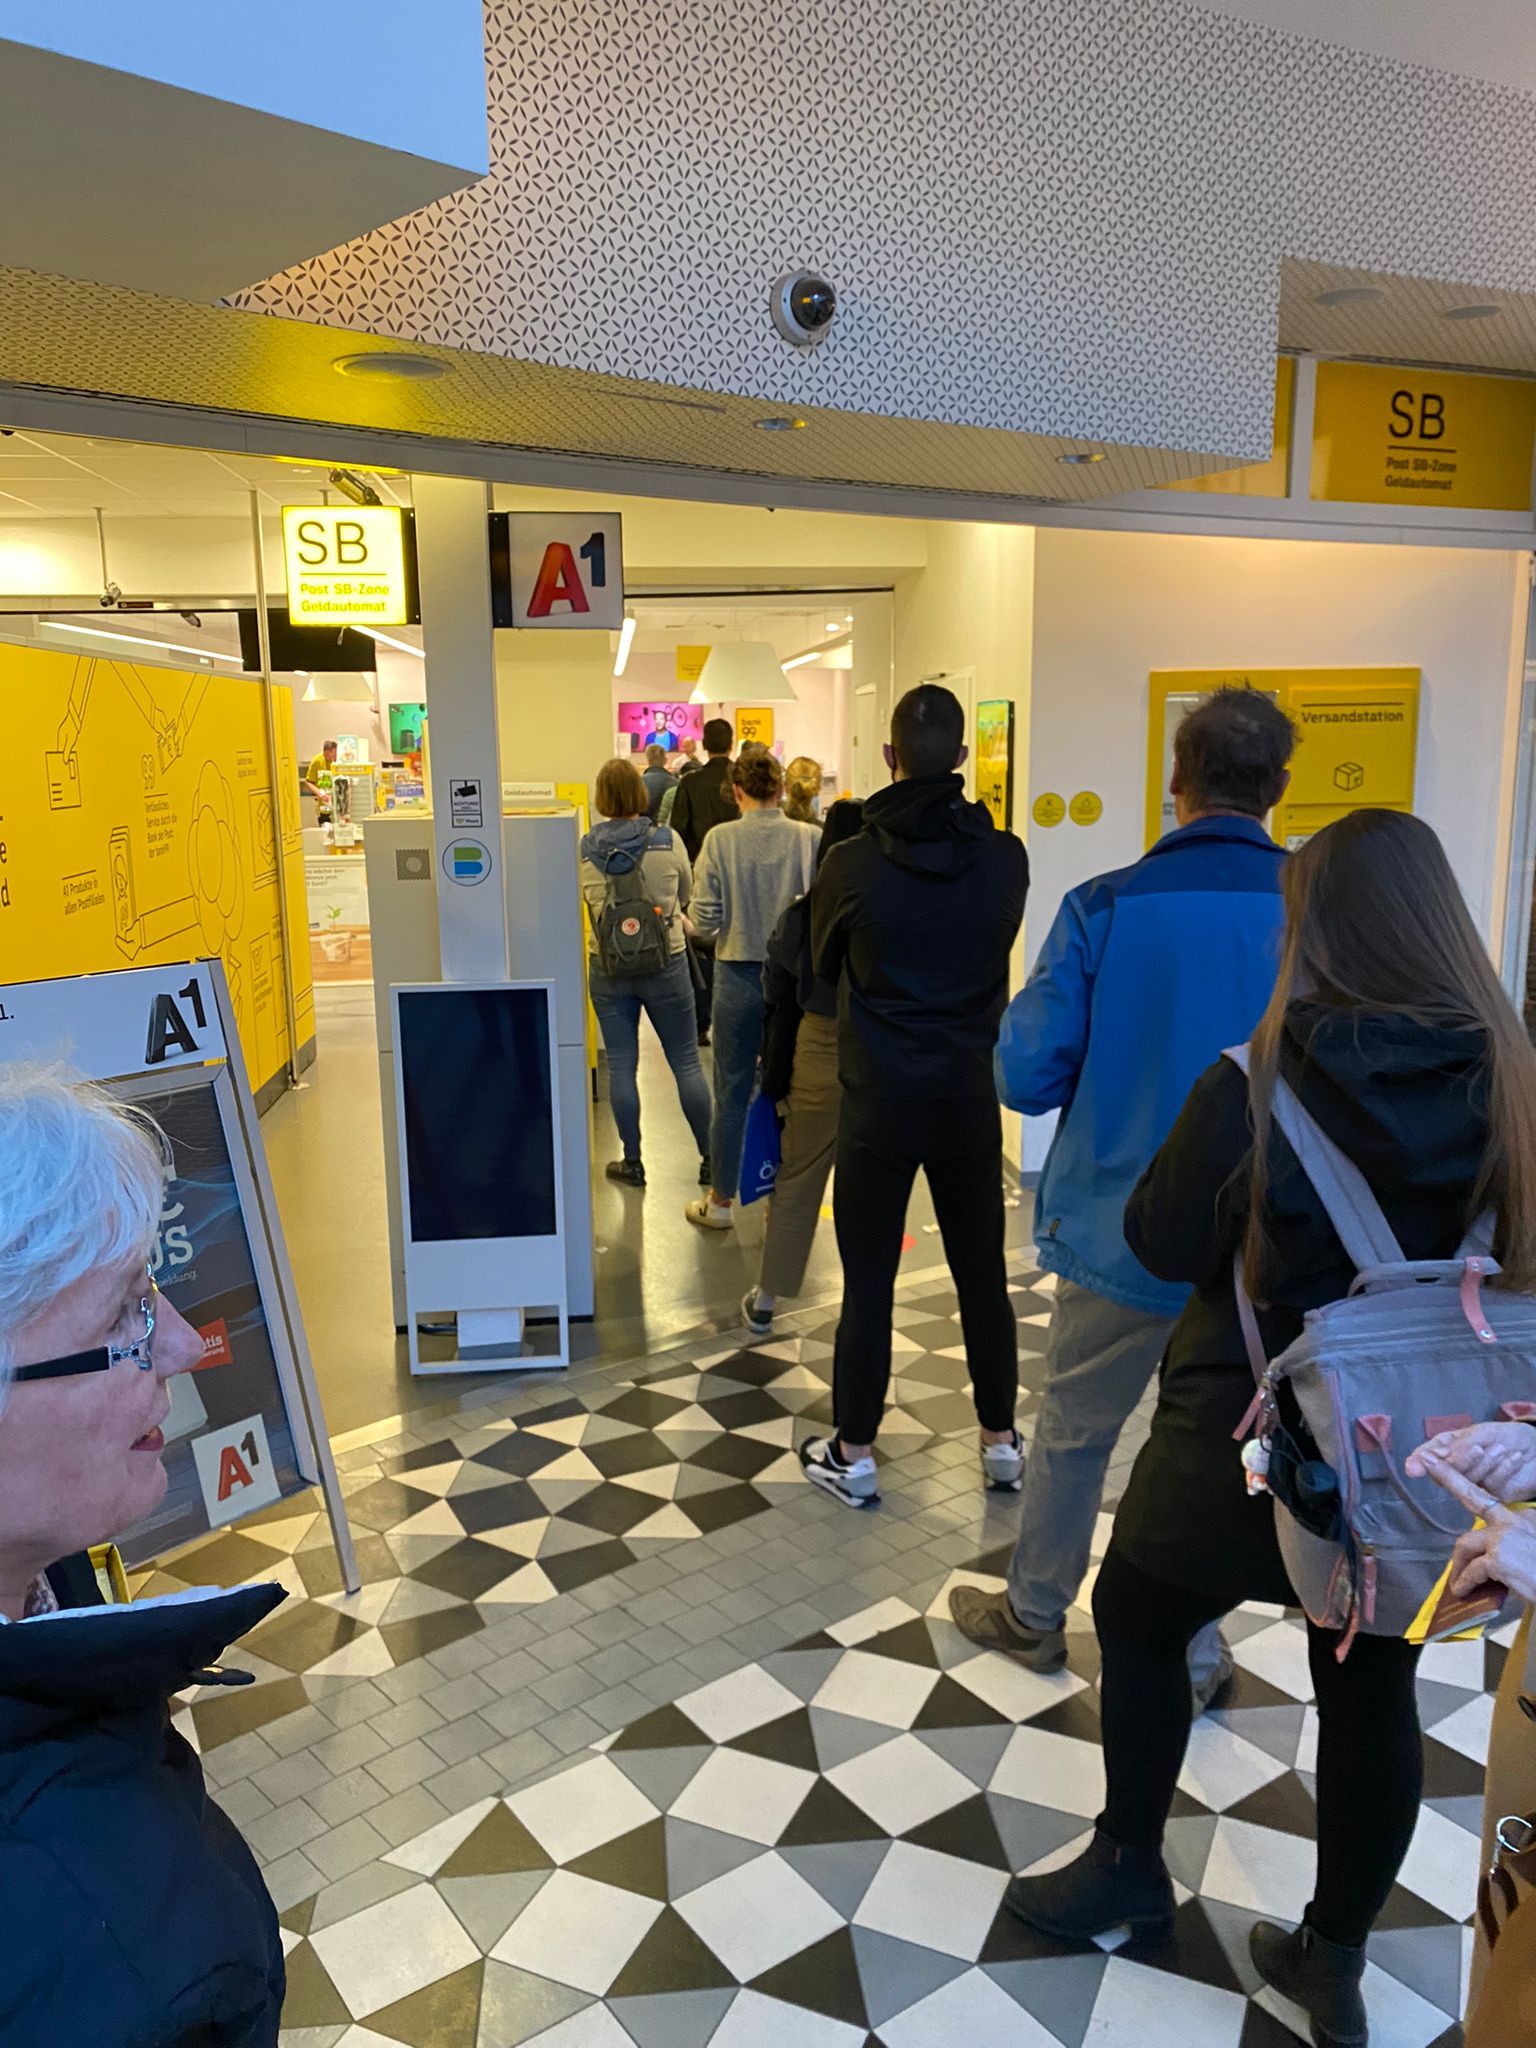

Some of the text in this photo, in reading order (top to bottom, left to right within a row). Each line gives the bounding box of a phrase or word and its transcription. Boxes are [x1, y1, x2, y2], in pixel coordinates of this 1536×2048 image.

[1388, 390, 1445, 440] SB
[1386, 456, 1457, 473] Post SB-Zone
[1385, 475, 1452, 490] Geldautomat
[298, 521, 368, 565] SB
[526, 531, 606, 618] A1
[300, 583, 390, 596] Post SB-Zone
[301, 600, 386, 612] Geldautomat
[1302, 711, 1404, 724] Versandstation
[504, 789, 552, 797] Geldautomat
[145, 978, 207, 1065] A1
[217, 1430, 260, 1502] A1
